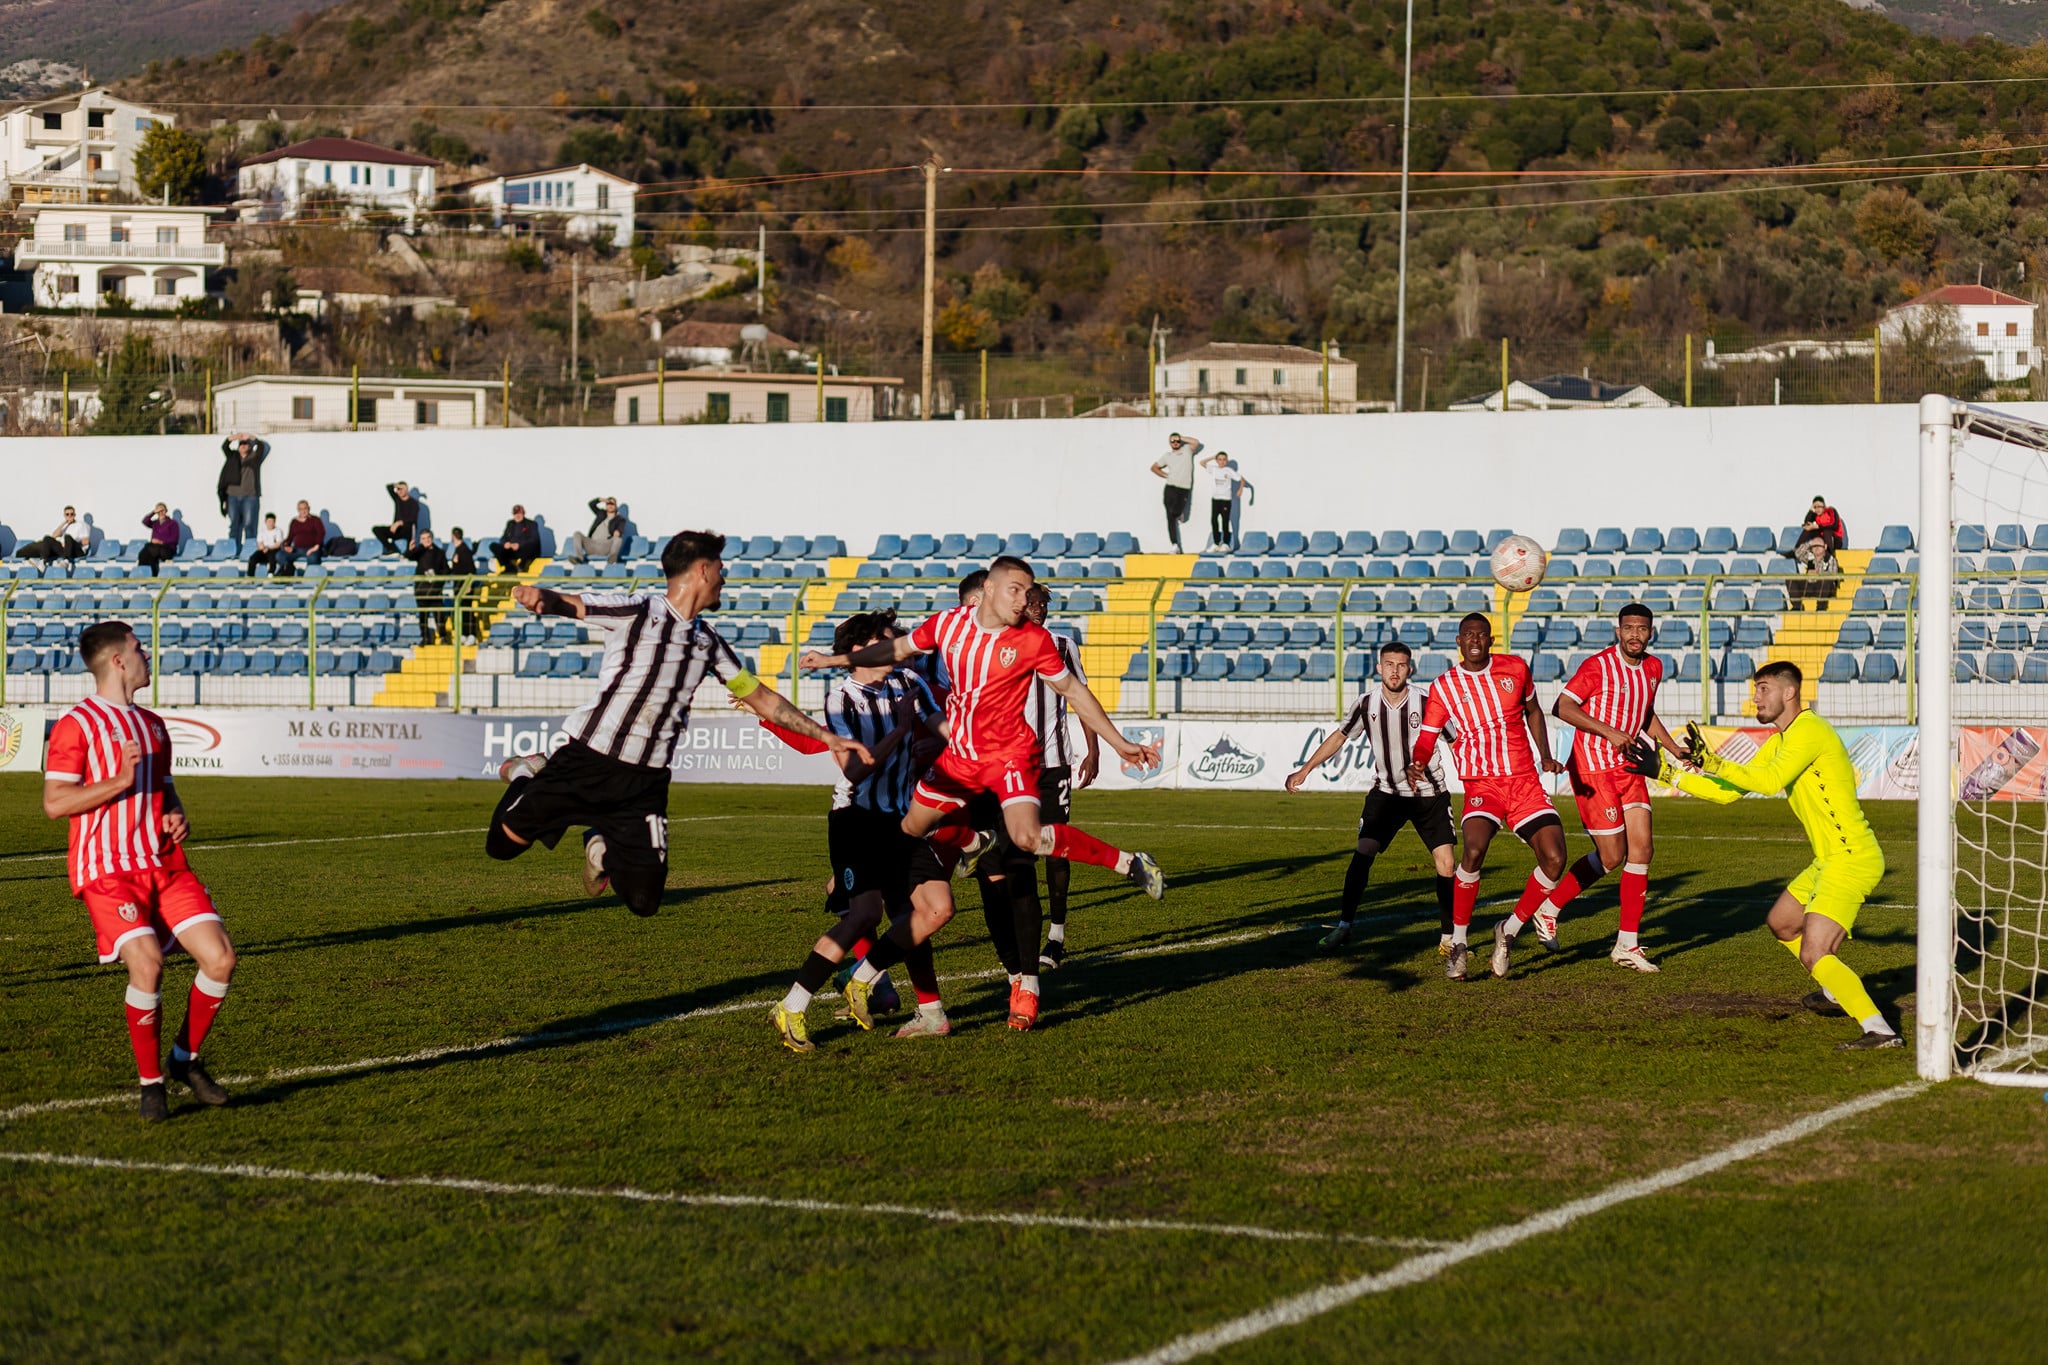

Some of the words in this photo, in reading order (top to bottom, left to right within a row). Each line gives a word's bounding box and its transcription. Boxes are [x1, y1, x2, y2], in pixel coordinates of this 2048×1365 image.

[288, 720, 304, 737] M
[309, 720, 322, 737] &
[328, 720, 340, 738] G
[346, 721, 422, 740] RENTAL
[483, 721, 570, 761] Haie
[175, 757, 224, 768] RENTAL
[670, 754, 721, 770] USTIN
[1196, 755, 1256, 782] Lajthiza
[1003, 770, 1025, 793] 11
